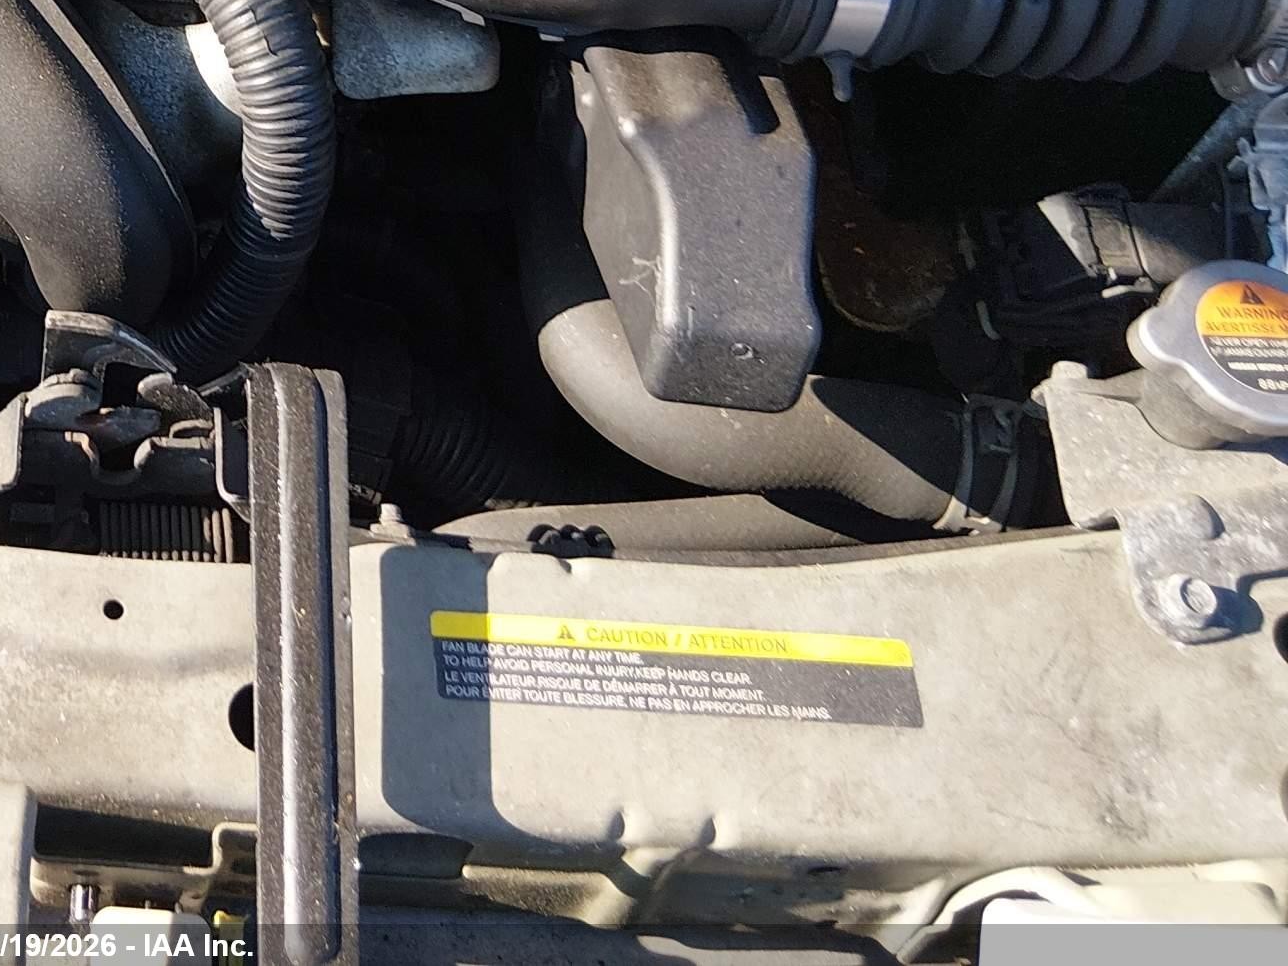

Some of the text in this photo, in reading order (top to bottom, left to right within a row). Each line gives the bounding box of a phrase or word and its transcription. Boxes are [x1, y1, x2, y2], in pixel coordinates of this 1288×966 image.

[442, 641, 644, 666] FAN BLADE CAN START AT ANY TIME.
[586, 626, 666, 647] CAUTION
[689, 633, 787, 653] ATTENTION
[443, 654, 459, 666] TO
[461, 656, 491, 669] HELP
[493, 658, 529, 672] AVOID
[530, 659, 594, 676] PERSONAL
[667, 666, 710, 683] HANDS
[444, 670, 460, 682] LE
[461, 672, 536, 687] VENTILATEUR
[537, 675, 582, 690] RISQUE
[583, 678, 601, 691] DE
[602, 678, 667, 696] DÉMARRER
[668, 681, 678, 696] À
[679, 684, 710, 698] TOUT
[445, 684, 480, 698] POUR
[522, 689, 562, 703] TOUTE
[629, 695, 647, 709] NE
[648, 697, 672, 711] PAS
[673, 698, 691, 711] EN
[692, 700, 766, 715] APPROCHER
[767, 704, 791, 717] LES
